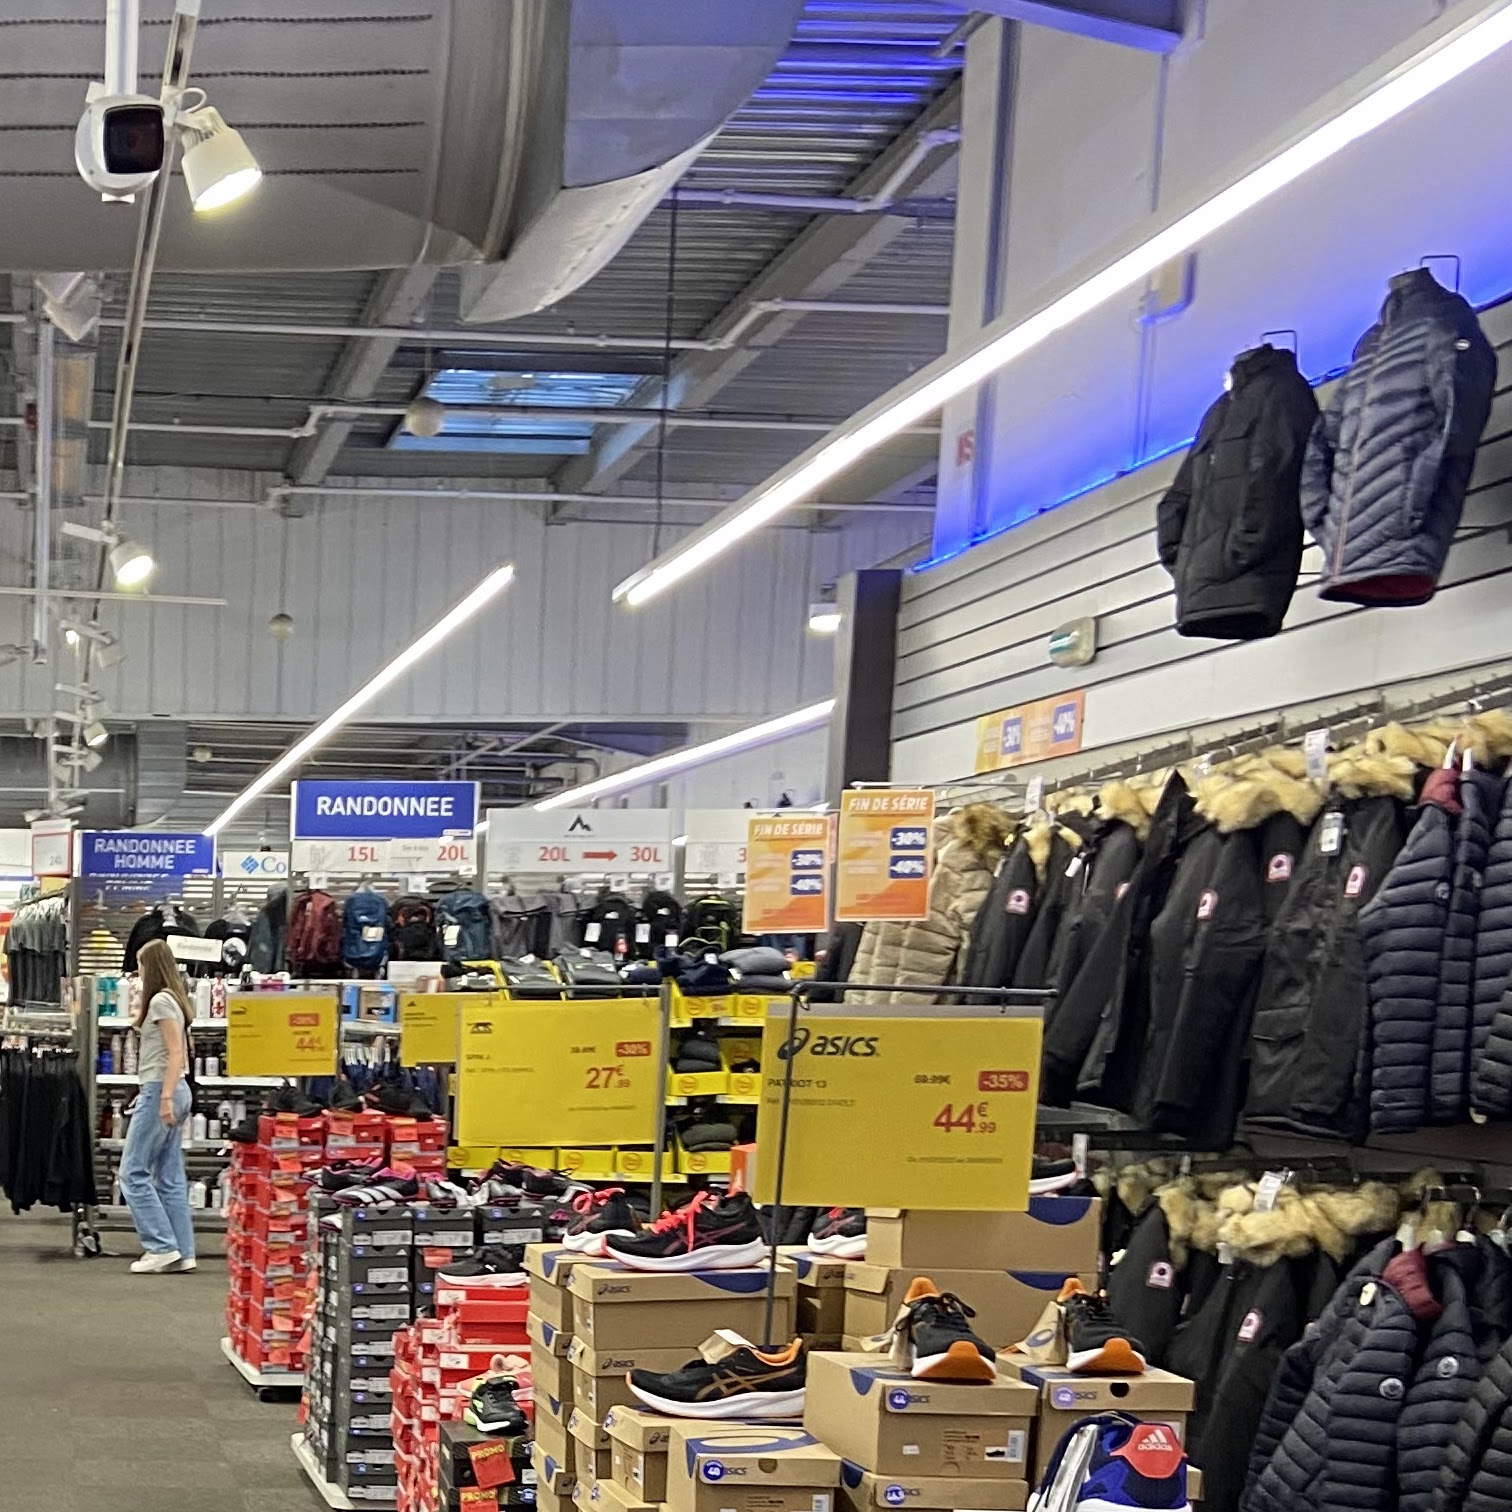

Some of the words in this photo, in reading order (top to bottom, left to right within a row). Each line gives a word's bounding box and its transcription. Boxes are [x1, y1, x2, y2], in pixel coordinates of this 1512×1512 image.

[317, 796, 455, 817] RANDONNEE
[849, 799, 869, 811] FIN
[872, 798, 888, 810] DE
[891, 796, 929, 811] SÉRIE
[754, 825, 772, 835] FIN
[775, 824, 791, 834] DE
[794, 822, 824, 834] SÉRIE
[94, 838, 196, 854] RANDONNEE
[348, 846, 378, 862] 15L
[437, 845, 468, 861] 20L
[539, 846, 570, 862] 20L
[114, 855, 175, 869] HOMME
[630, 846, 662, 863] 30L
[768, 1079, 812, 1089] PATIOT
[982, 1073, 1025, 1089] -35%
